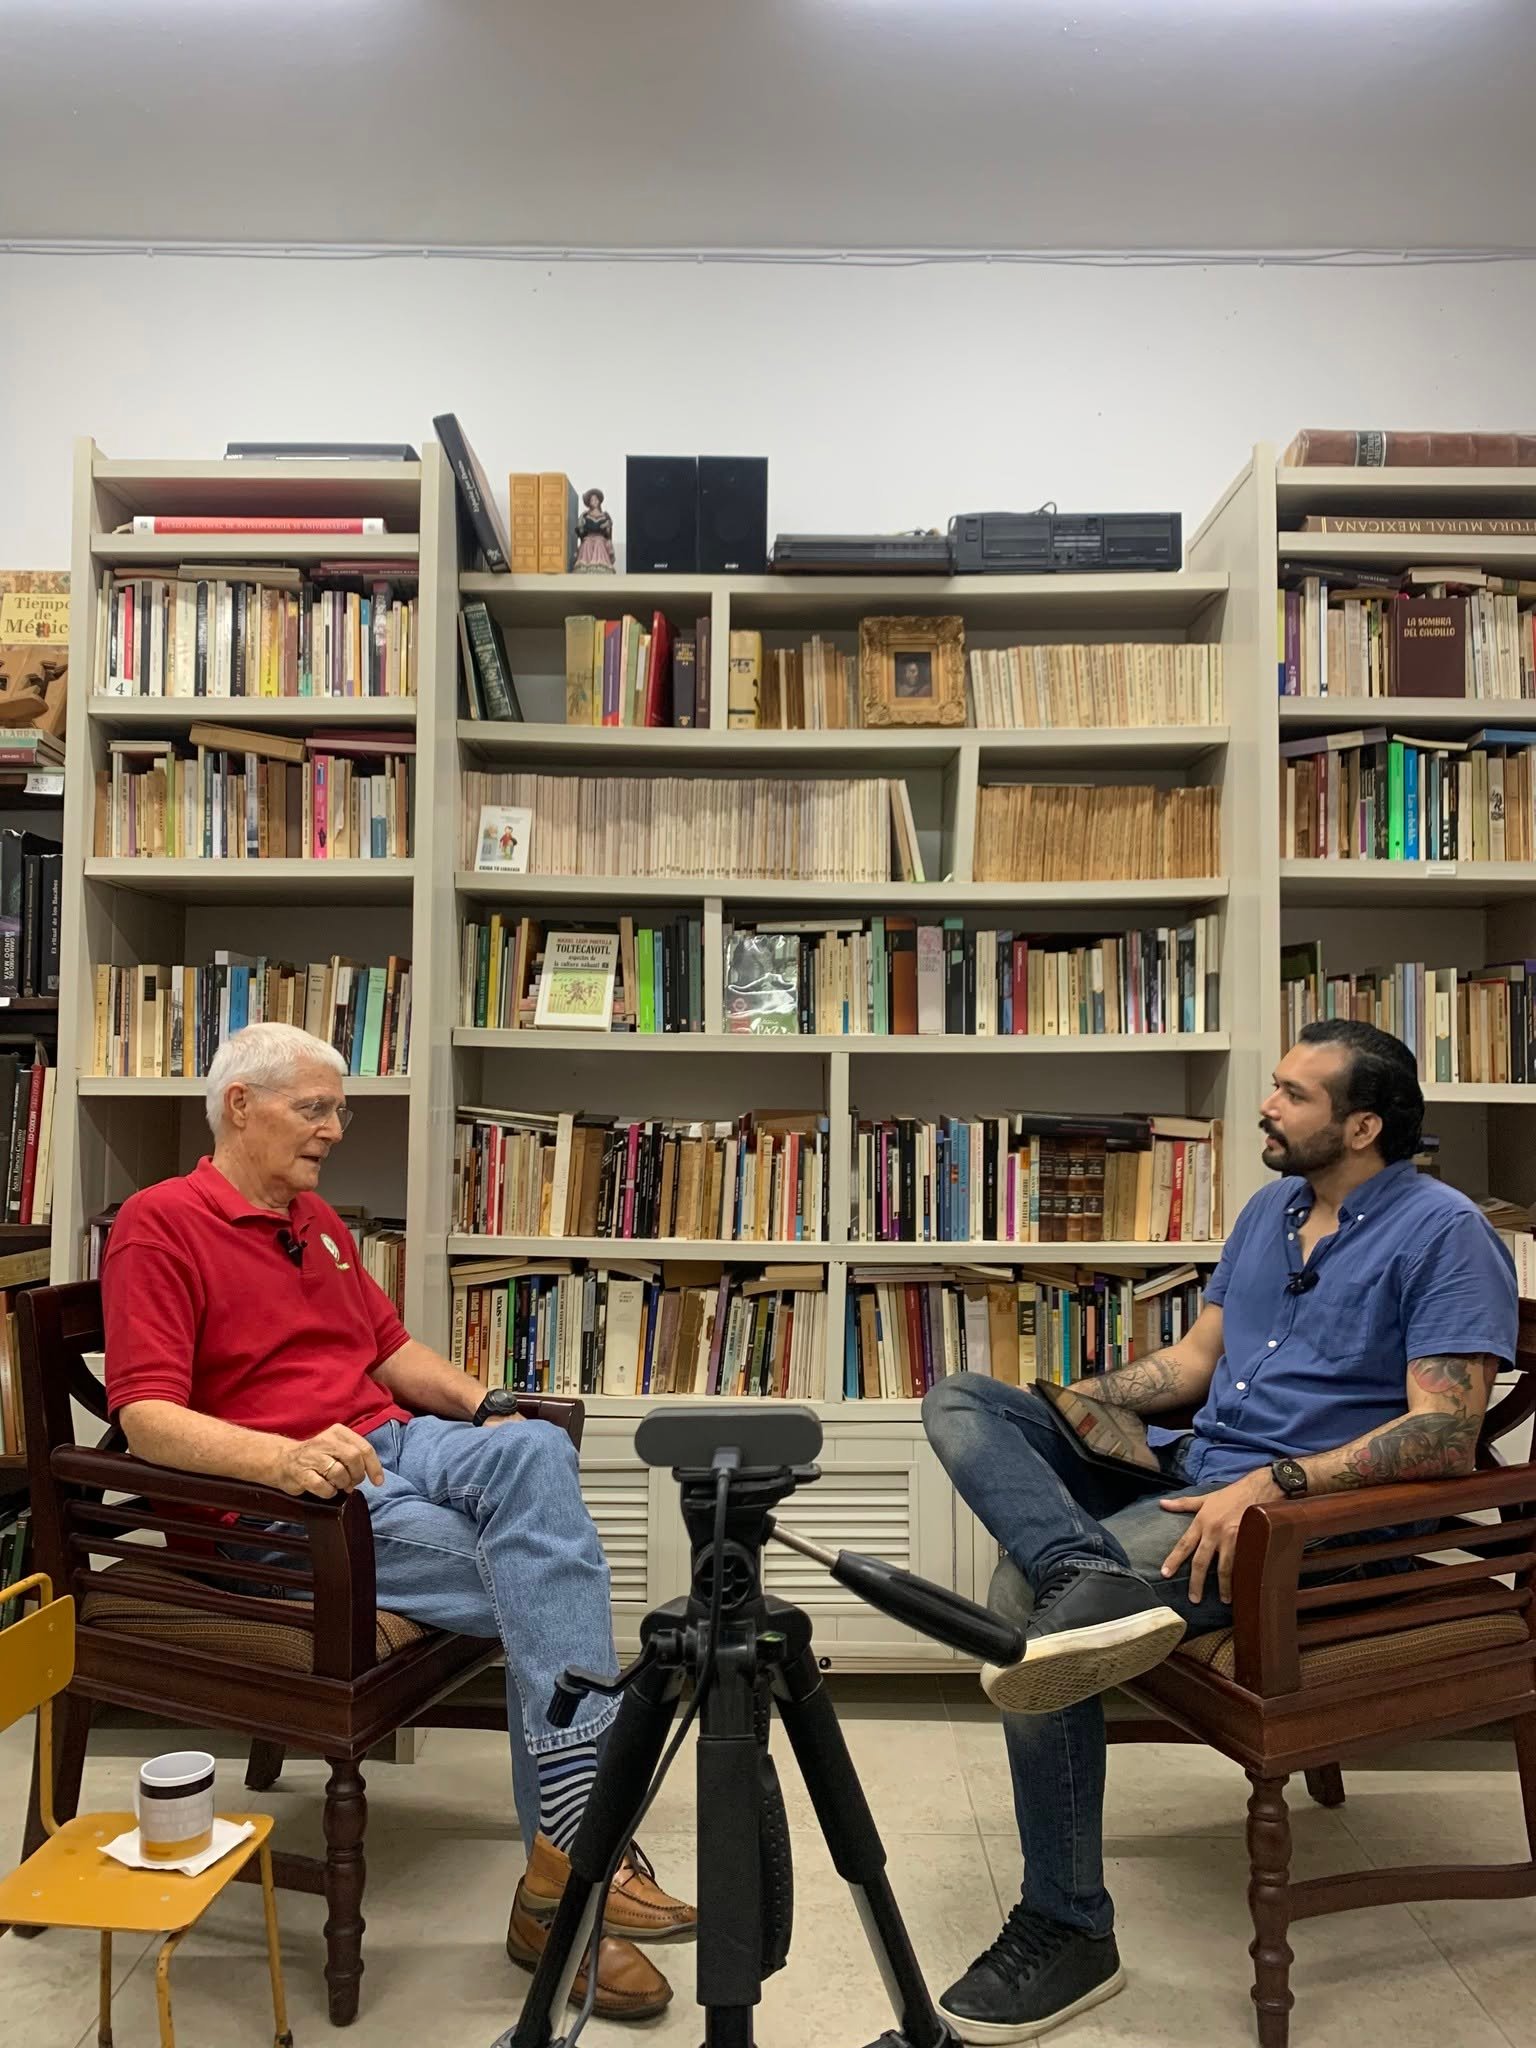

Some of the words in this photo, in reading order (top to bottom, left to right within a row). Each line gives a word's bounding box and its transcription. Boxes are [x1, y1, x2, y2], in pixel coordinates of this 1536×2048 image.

[1334, 520, 1422, 532] MEXICANA
[1430, 520, 1482, 532] MURAL
[34, 609, 52, 620] de
[1407, 617, 1416, 627] LA
[1418, 616, 1452, 627] SOMBRA
[1404, 627, 1417, 637] DEL
[1419, 627, 1456, 637] CAUDILLO
[115, 682, 125, 695] 4
